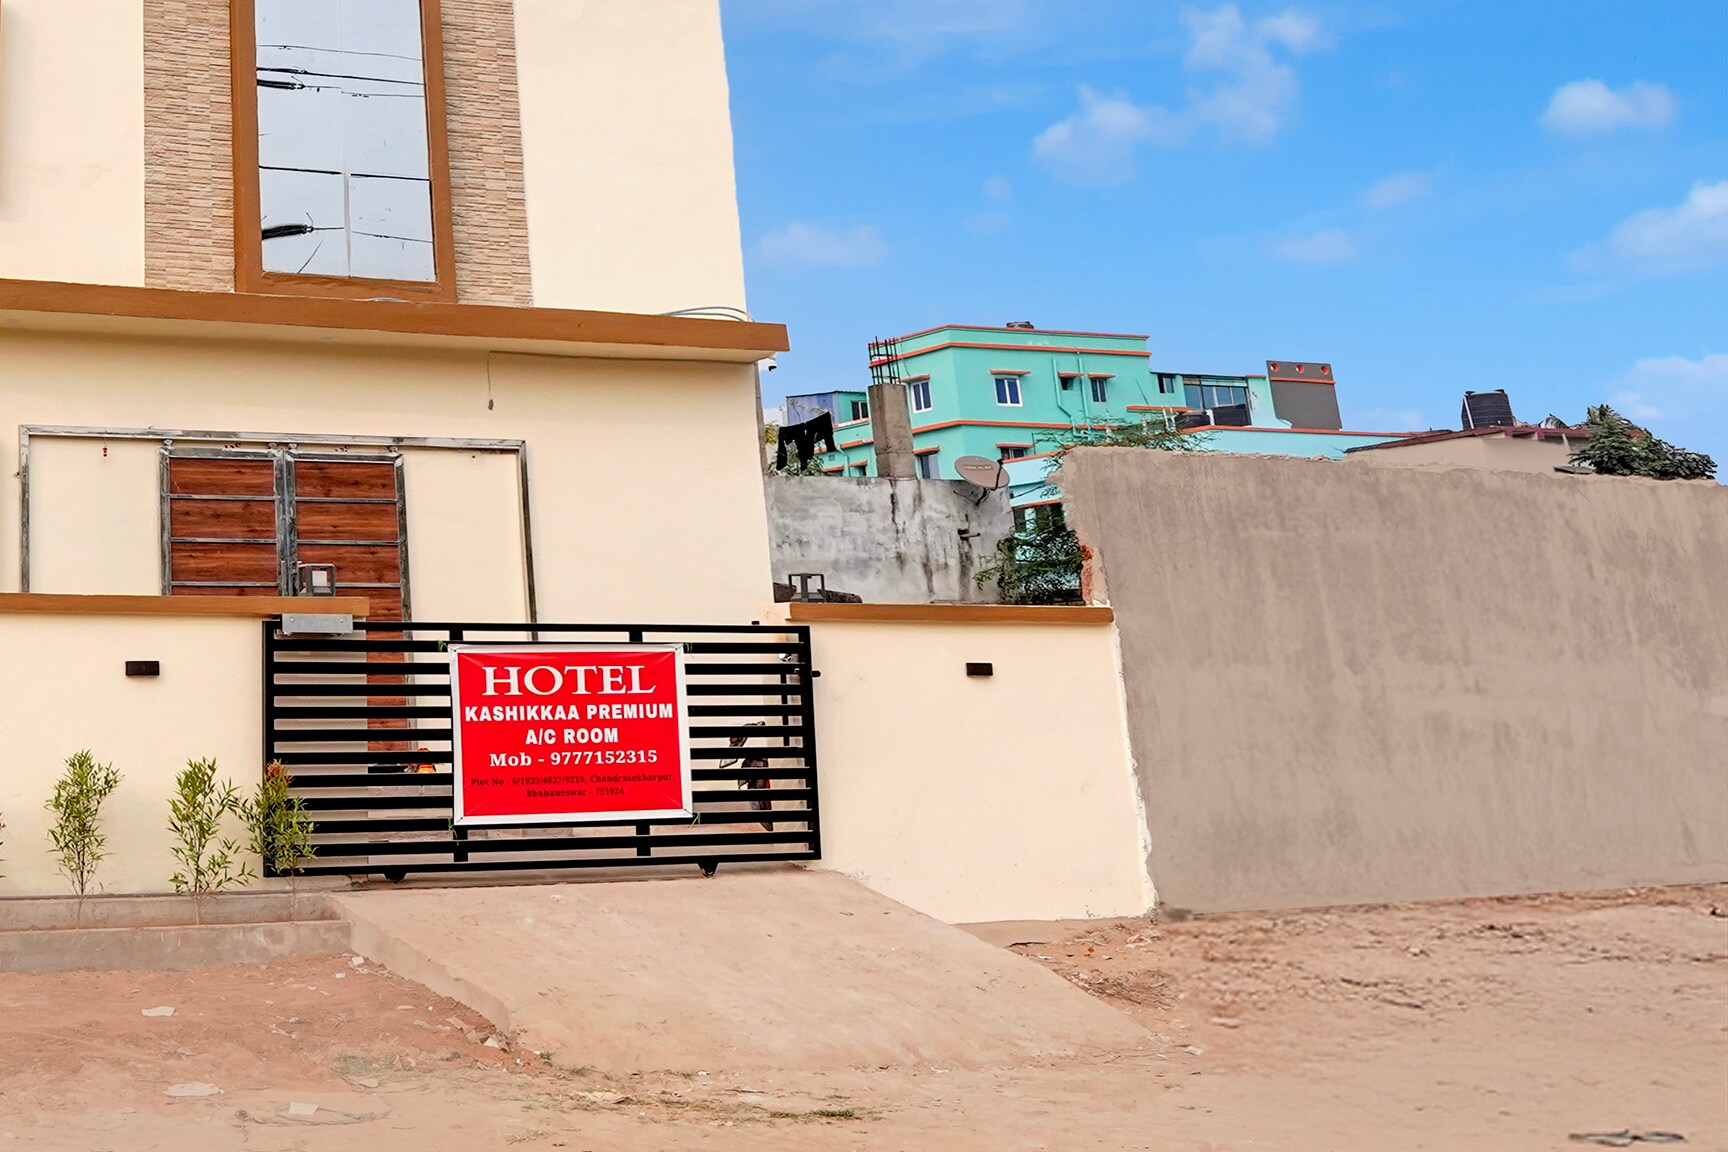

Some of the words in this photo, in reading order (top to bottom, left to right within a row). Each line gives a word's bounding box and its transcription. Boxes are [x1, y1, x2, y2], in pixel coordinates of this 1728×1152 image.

[482, 665, 657, 696] HOTEL
[465, 704, 580, 722] KASHIKKAA
[587, 703, 673, 720] PREMIUM
[525, 729, 557, 745] A/C
[563, 728, 619, 744] ROOM
[489, 752, 532, 767] Mob
[550, 750, 658, 765] 9777152315
[471, 778, 489, 786] Plot
[491, 777, 505, 786] No
[525, 788, 587, 798] Bhubaneswar
